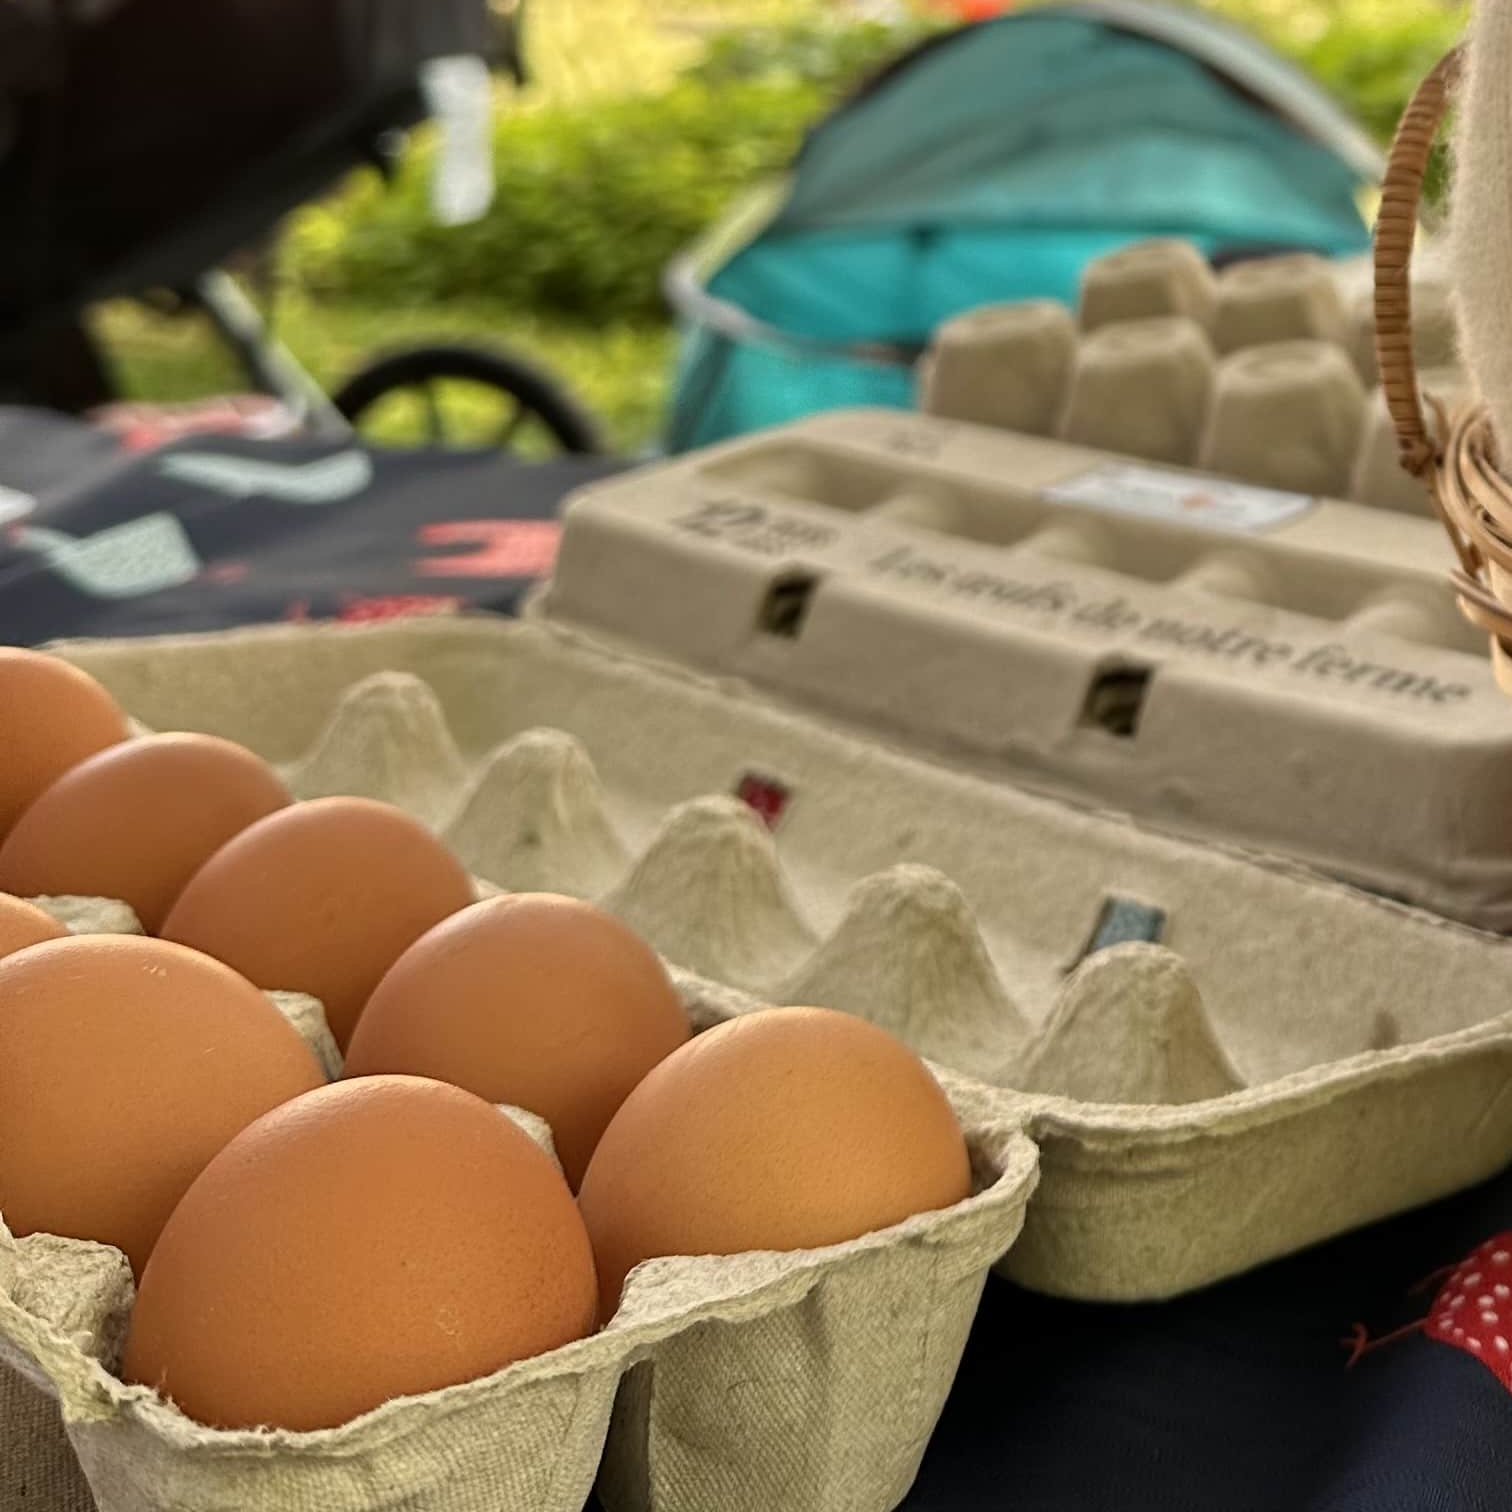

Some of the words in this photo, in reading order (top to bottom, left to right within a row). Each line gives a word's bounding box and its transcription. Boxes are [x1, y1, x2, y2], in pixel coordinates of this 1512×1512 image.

[866, 545, 957, 582] Les
[1070, 597, 1142, 631] de
[1138, 617, 1294, 664] notre
[1293, 642, 1472, 704] ferme
